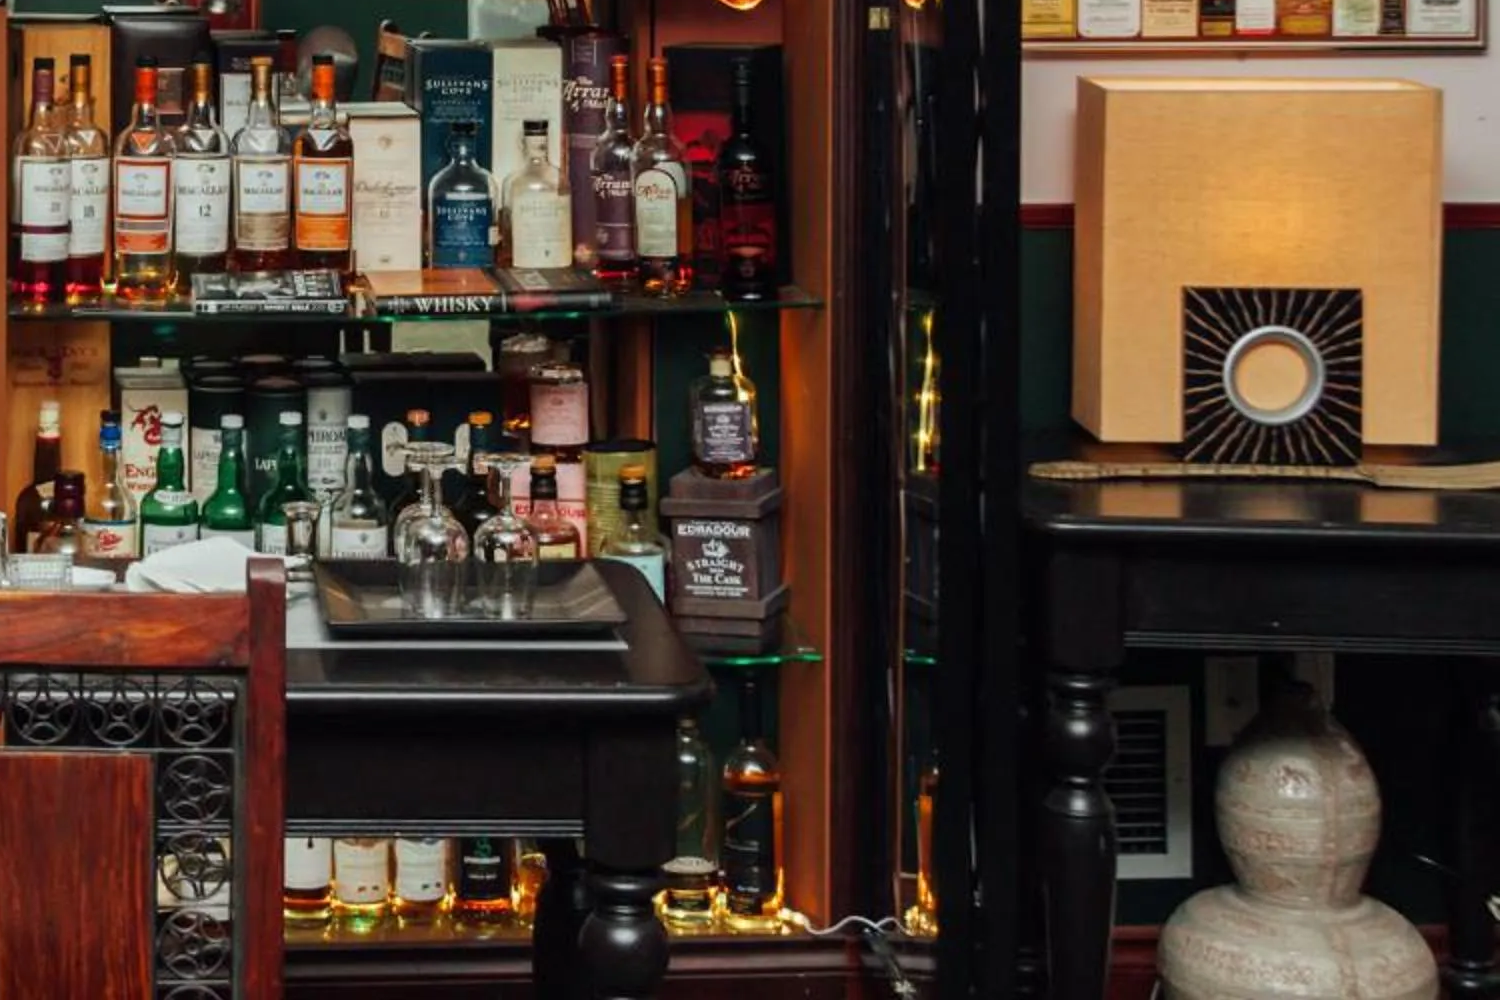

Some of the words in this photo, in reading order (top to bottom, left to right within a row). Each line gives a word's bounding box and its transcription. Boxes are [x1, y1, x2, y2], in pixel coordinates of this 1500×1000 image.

[198, 204, 212, 217] 12
[414, 296, 494, 313] WHISKY
[677, 524, 751, 538] EDRADOUR
[686, 558, 746, 575] STRAIGHT
